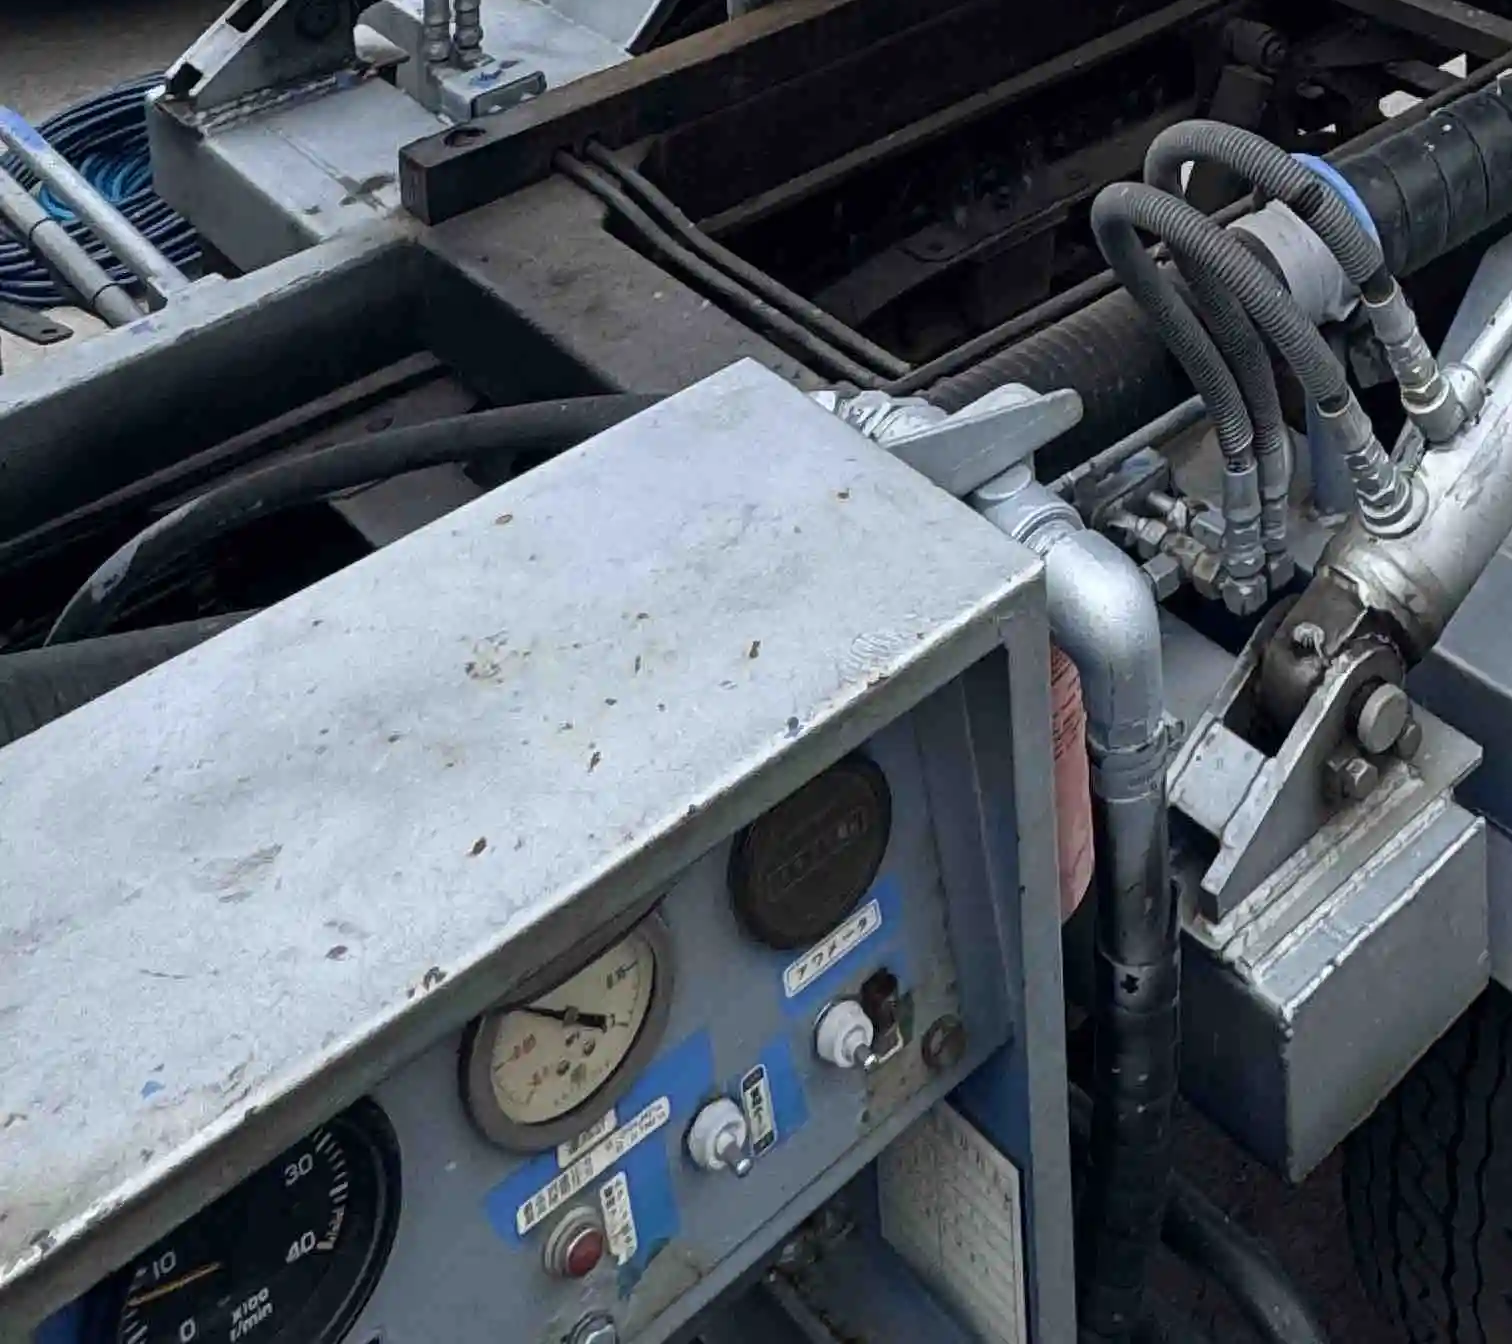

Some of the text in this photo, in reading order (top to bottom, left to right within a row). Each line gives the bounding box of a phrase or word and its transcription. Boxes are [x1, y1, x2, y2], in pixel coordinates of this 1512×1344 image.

[284, 1153, 314, 1188] 30
[285, 1230, 316, 1264] 40
[153, 1250, 177, 1280] 10
